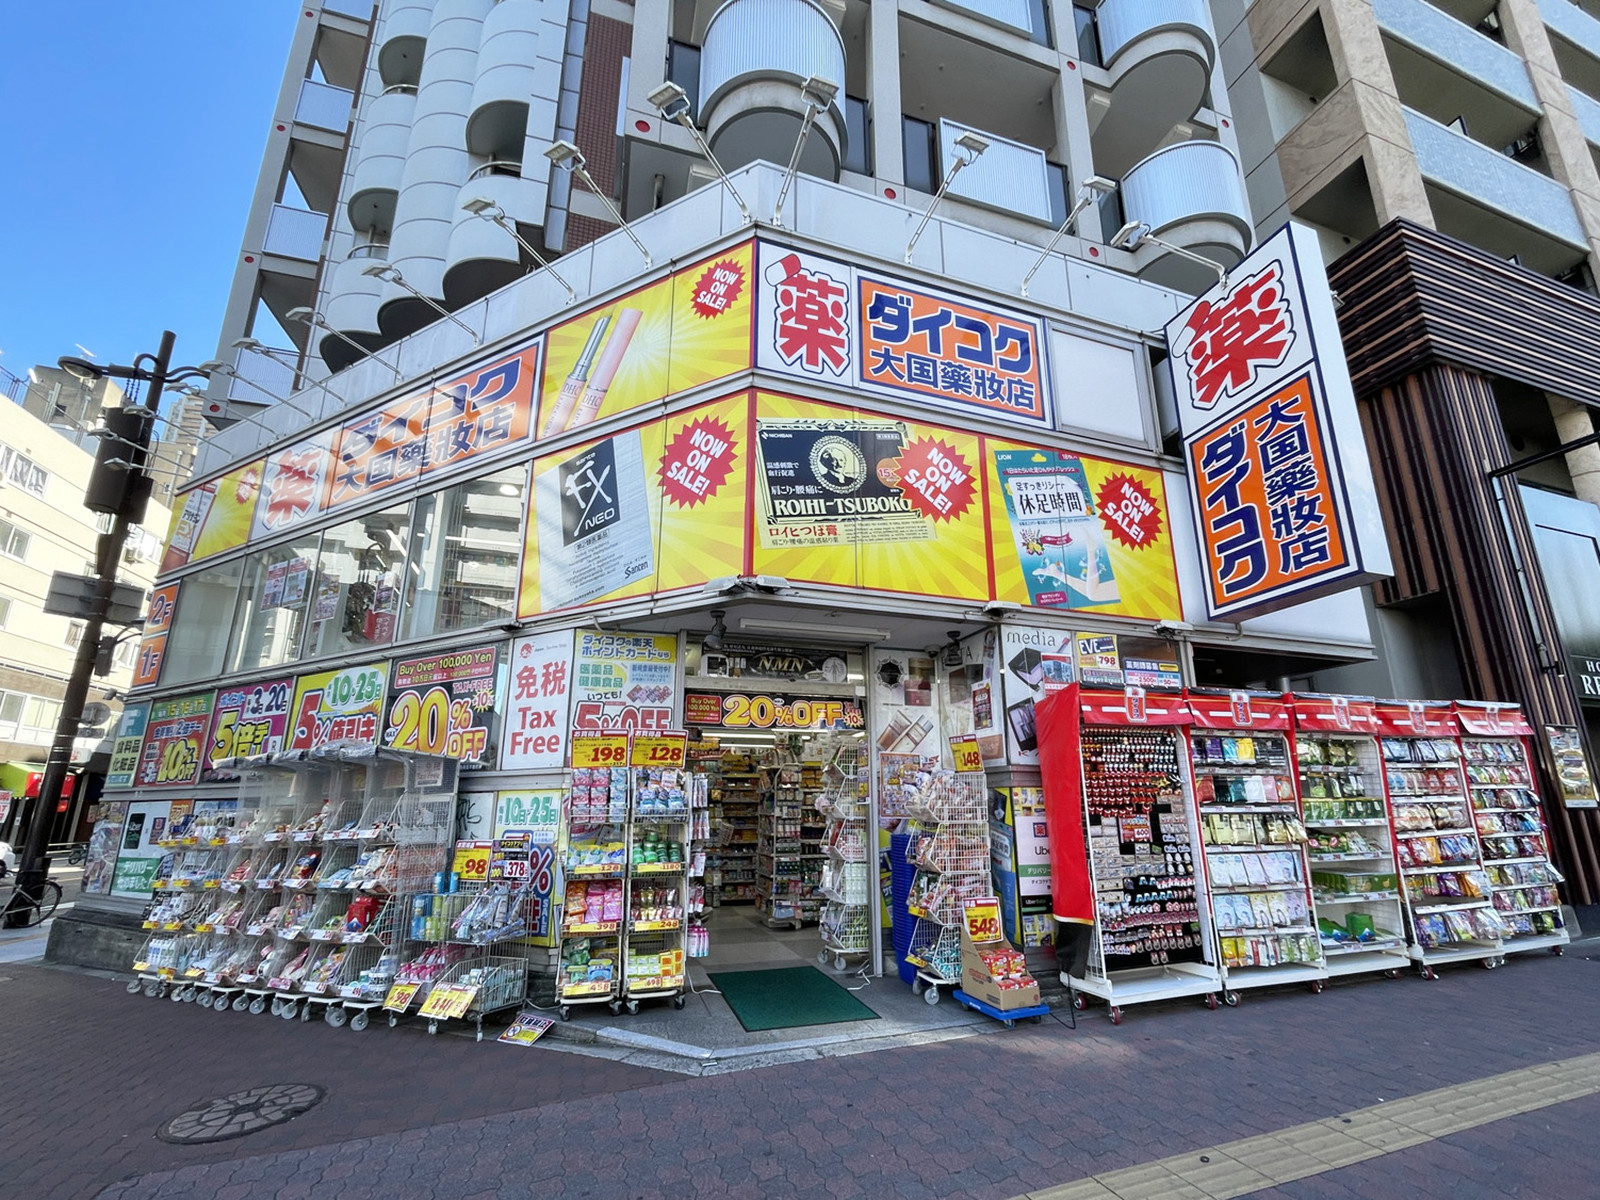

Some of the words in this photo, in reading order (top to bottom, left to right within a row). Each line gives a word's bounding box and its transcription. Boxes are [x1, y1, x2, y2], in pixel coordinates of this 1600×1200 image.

[710, 282, 728, 294] ON
[712, 268, 739, 285] NOW
[696, 291, 727, 310] SALE!
[776, 270, 847, 373] 薬
[866, 291, 1036, 375] ダイコク
[1190, 264, 1288, 409] 薬
[563, 382, 582, 397] DHC
[583, 393, 602, 408] DHC
[341, 355, 523, 464] ダイコク
[690, 428, 728, 459] NOW
[686, 452, 711, 473] ON
[926, 447, 967, 485] NOW
[264, 446, 323, 528] 薬
[667, 461, 711, 496] SALE!
[925, 466, 952, 493] ON
[565, 460, 613, 537] FX
[904, 468, 953, 515] SALE!
[1120, 482, 1154, 517] NOW
[773, 496, 911, 516] ROIHI-TSUBOKO
[1019, 492, 1083, 515] 休足時間
[1120, 500, 1142, 524] ON
[1200, 421, 1269, 597] ダイコク
[585, 507, 615, 530] NEO
[1104, 502, 1145, 542] SALE!
[769, 524, 838, 538] ロイヒつぼ膏
[624, 561, 649, 579] Santen
[151, 593, 172, 625] 2F
[1006, 631, 1056, 647] media
[1078, 640, 1100, 655] EVE
[140, 644, 159, 679] 1F
[399, 665, 414, 676] Buy
[416, 662, 436, 672] Over
[439, 654, 472, 669] 100,000
[474, 652, 492, 663] Yen
[579, 663, 613, 676] 医薬品
[757, 655, 805, 672] NMN
[1098, 656, 1116, 666] 798
[514, 660, 567, 701] 免税
[578, 676, 623, 688] 健康食品
[518, 706, 558, 730] Tax
[723, 694, 843, 728] 20%OFF
[447, 728, 489, 762] OFF
[510, 731, 560, 756] Free
[591, 746, 626, 762] 198
[648, 746, 683, 762] 128
[962, 751, 980, 766] 148
[465, 858, 488, 875] 98
[508, 861, 525, 876] 378
[968, 918, 998, 936] 548
